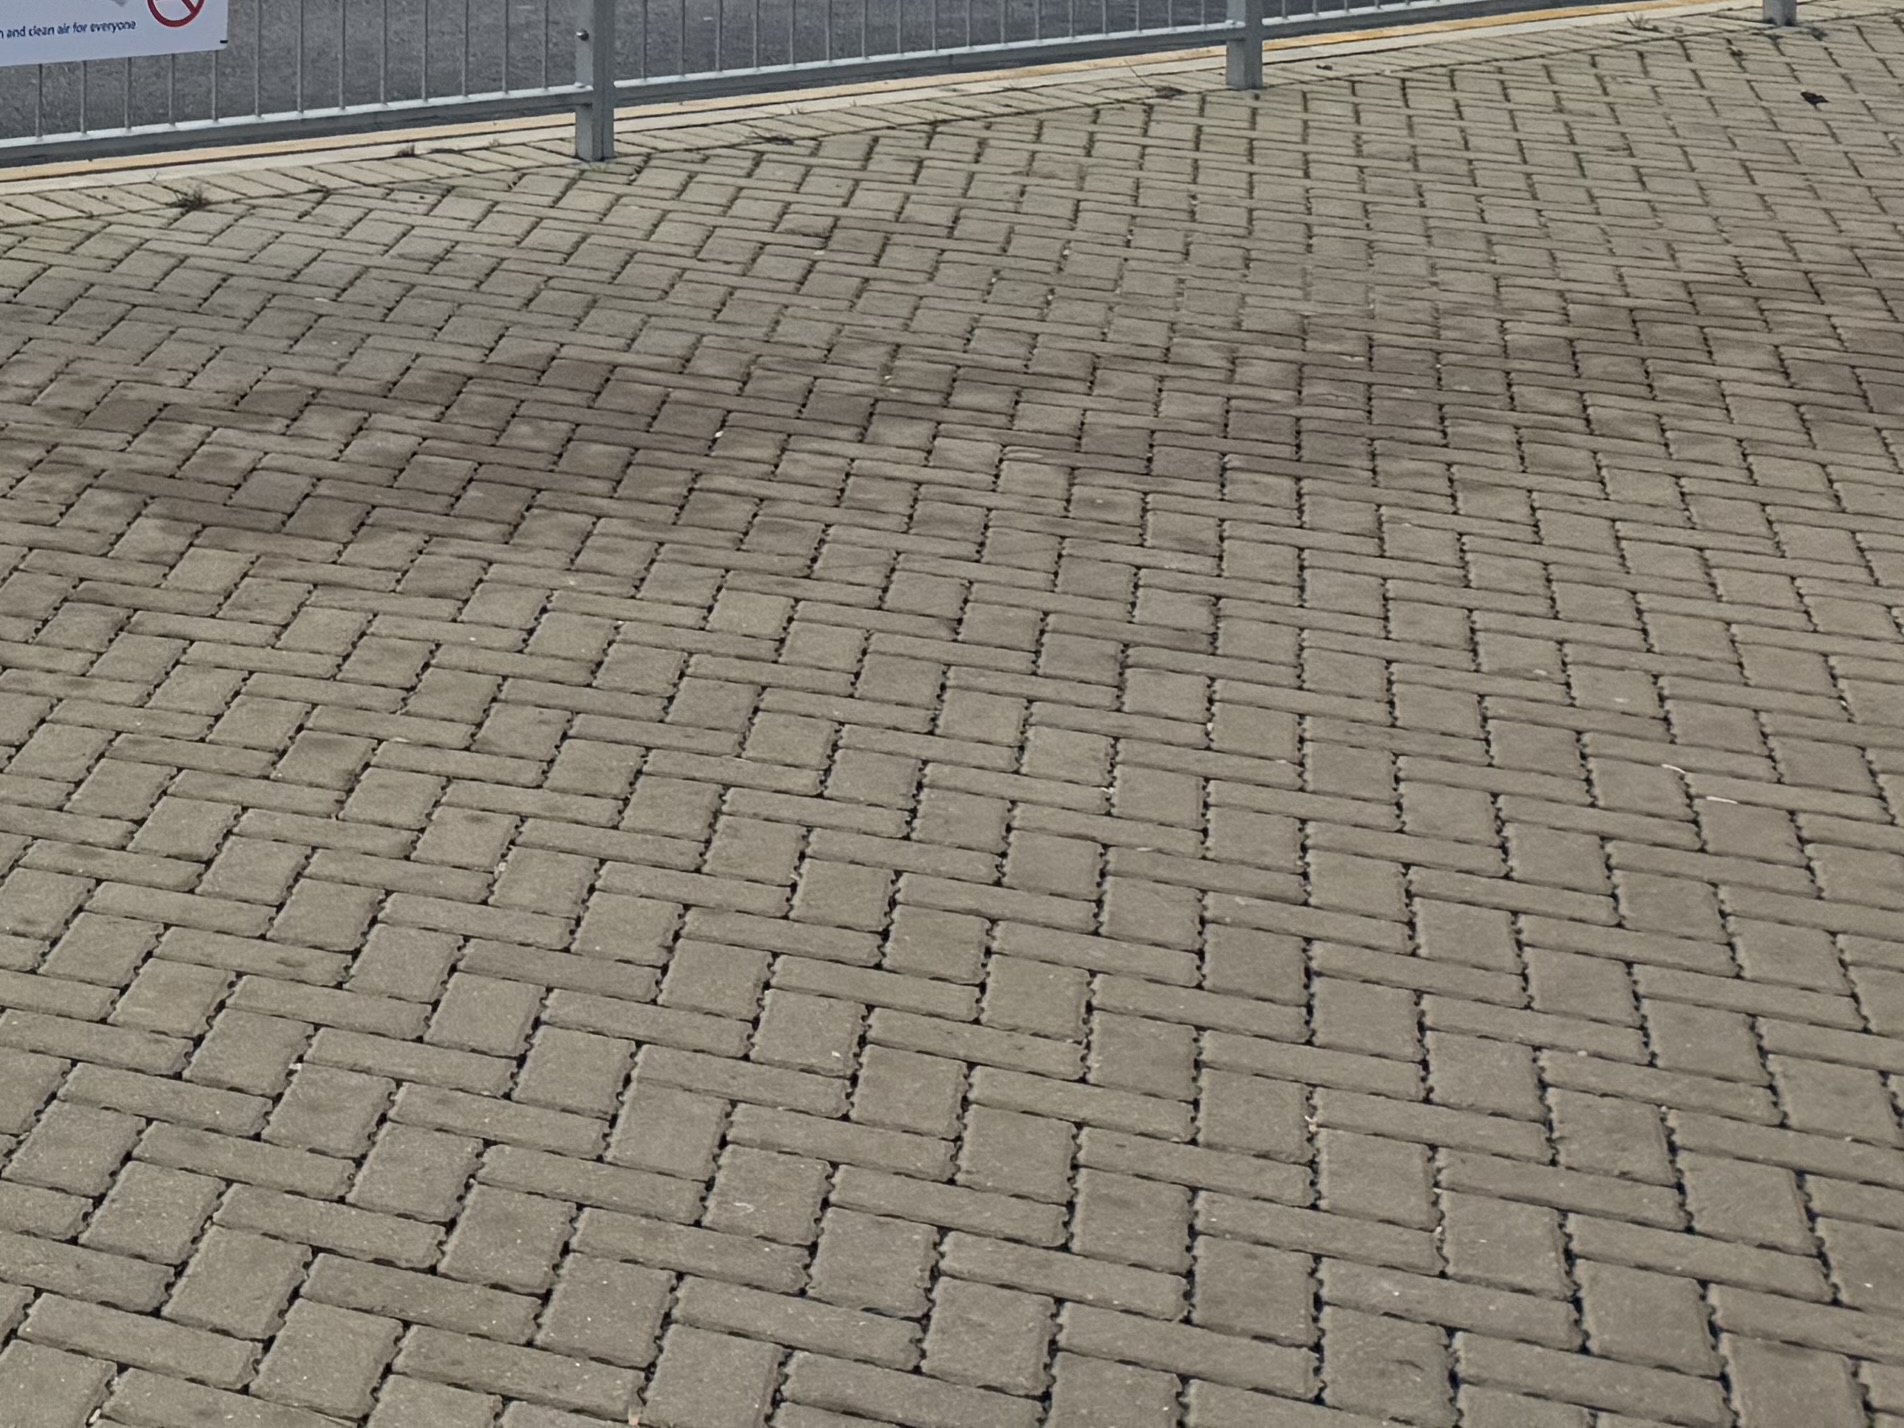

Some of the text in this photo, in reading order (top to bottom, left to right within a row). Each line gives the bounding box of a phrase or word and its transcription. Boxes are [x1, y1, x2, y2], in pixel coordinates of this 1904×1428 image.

[6, 26, 26, 38] and
[28, 24, 55, 37] clean
[57, 23, 70, 35] air
[72, 22, 87, 34] for
[90, 20, 136, 33] everyone
